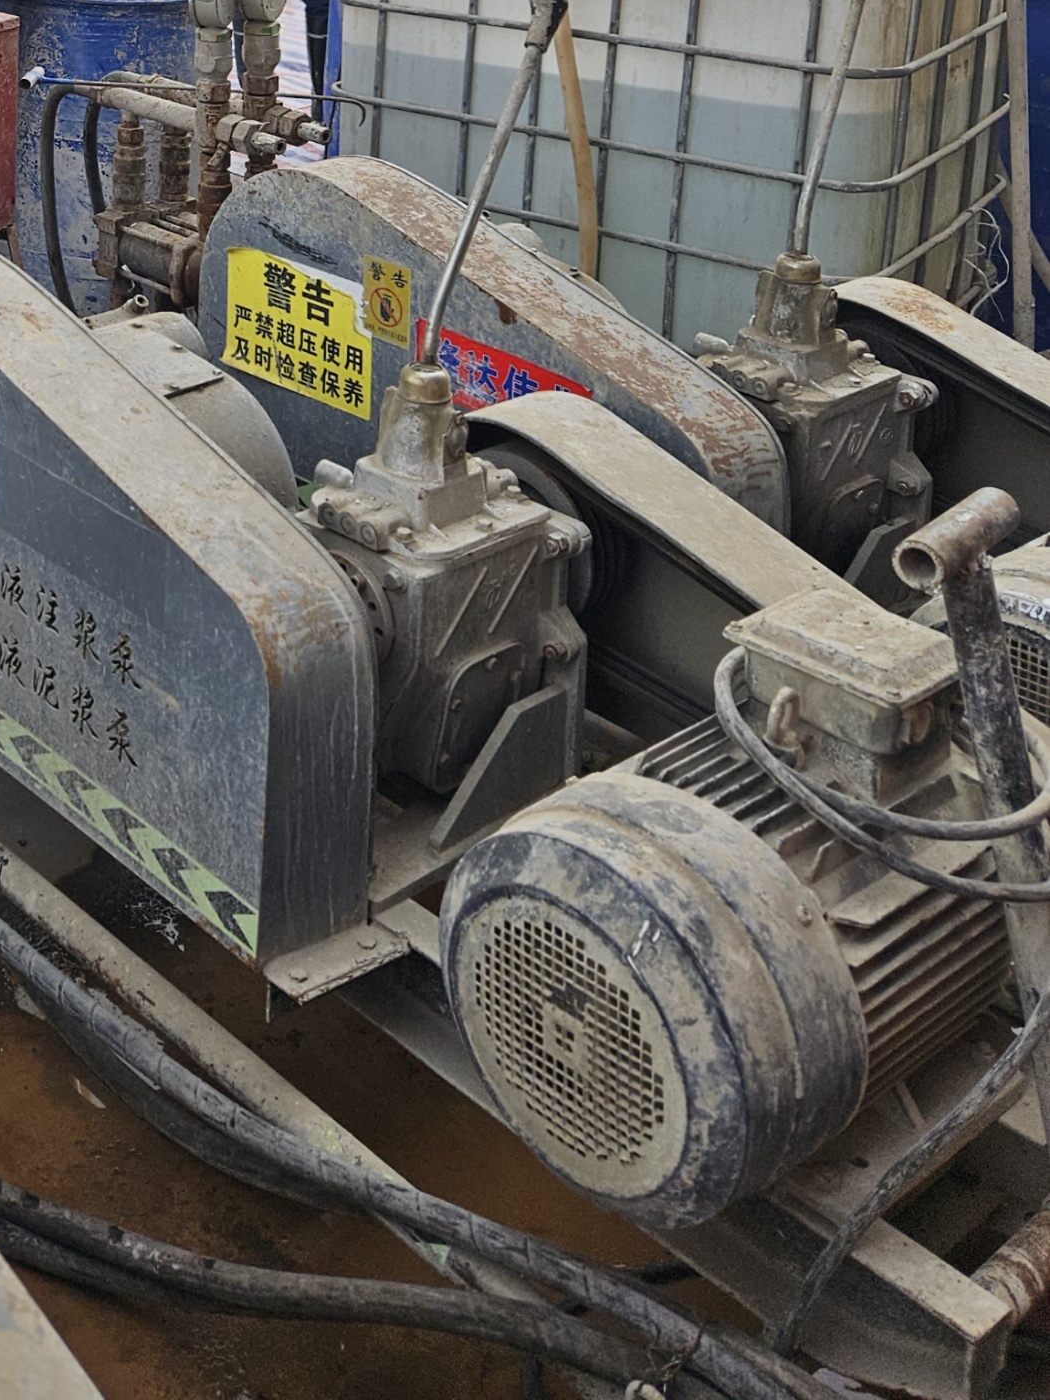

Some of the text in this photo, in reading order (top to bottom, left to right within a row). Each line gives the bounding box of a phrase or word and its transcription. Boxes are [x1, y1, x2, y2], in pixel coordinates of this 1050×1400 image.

[263, 261, 334, 327] 警告
[368, 261, 408, 289] 警告
[231, 335, 364, 408] 及时检查保养
[233, 304, 364, 376] 严禁超压使用
